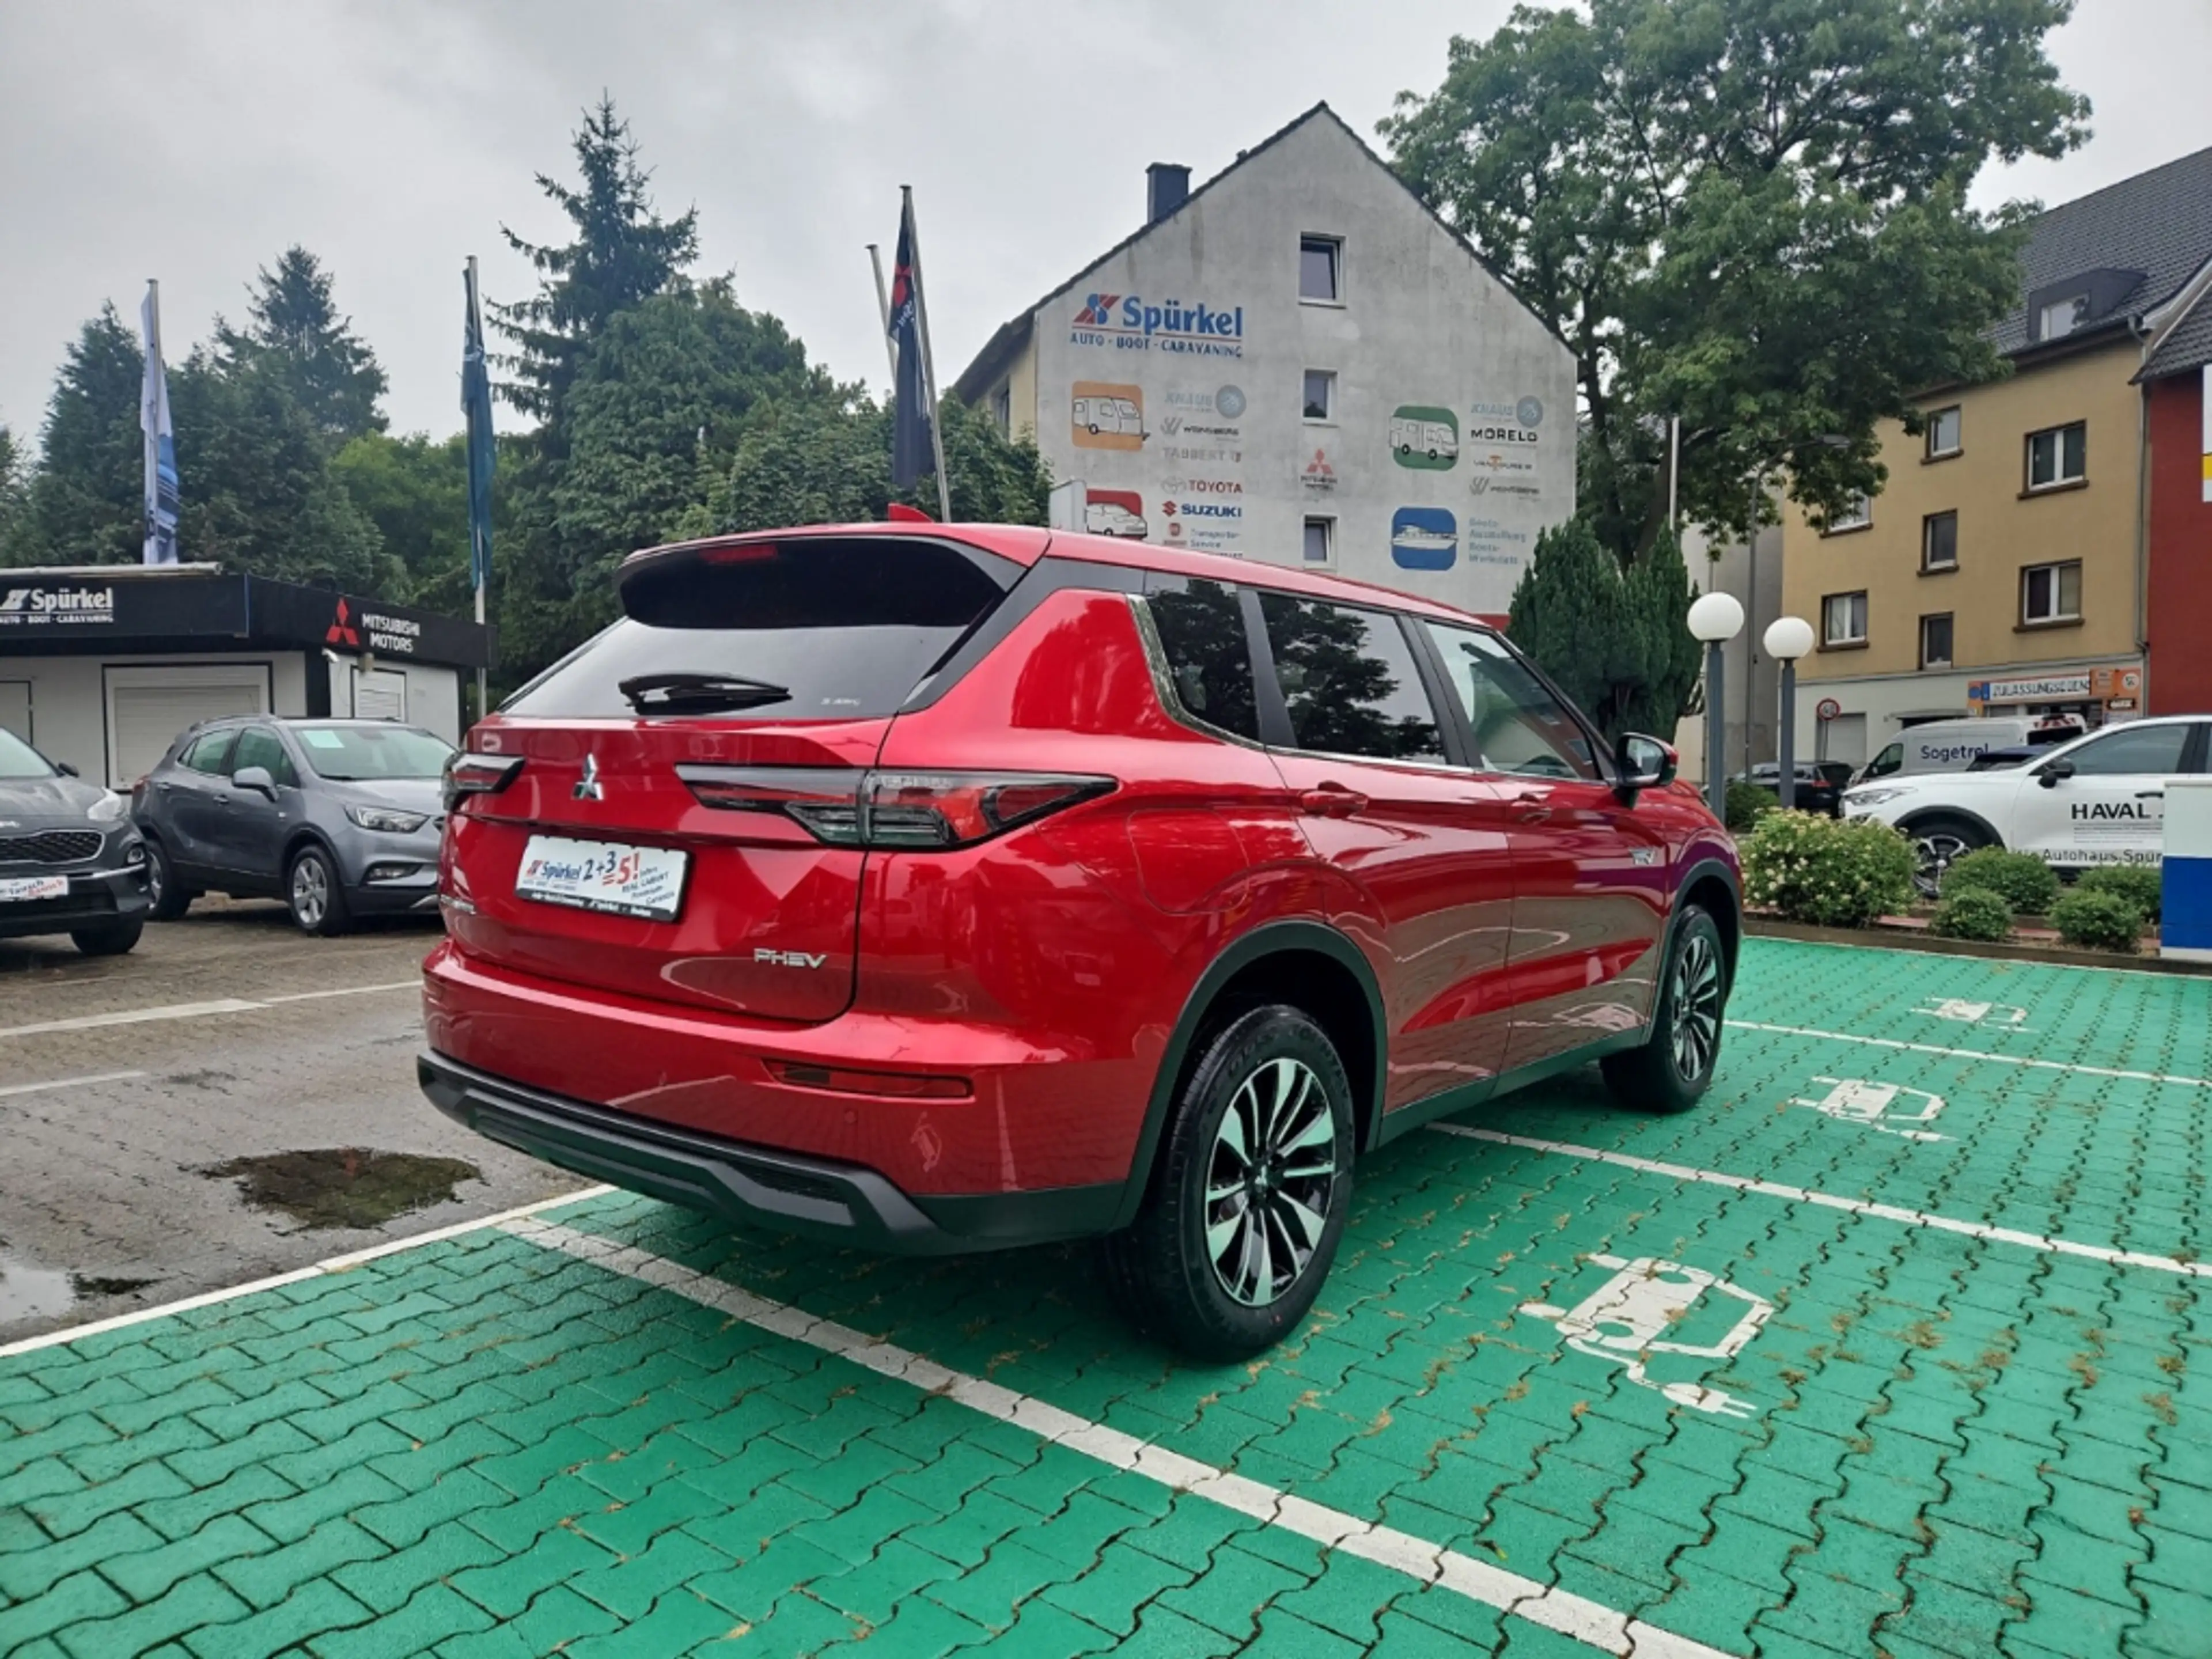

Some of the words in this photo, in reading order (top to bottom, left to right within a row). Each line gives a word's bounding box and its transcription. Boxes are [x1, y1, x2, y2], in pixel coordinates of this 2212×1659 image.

[1123, 296, 1242, 336] Spürkel
[1070, 332, 1105, 347] AUTO
[1471, 427, 1537, 441] MORELO
[1188, 479, 1243, 494] TOYOTA
[1181, 503, 1242, 517] SUZUKI
[31, 588, 113, 613] Spürkel
[362, 613, 421, 637] MITSUBISHI
[370, 632, 414, 653] MOTORS
[2071, 803, 2152, 819] HAVAL
[753, 948, 827, 968] PHEV
